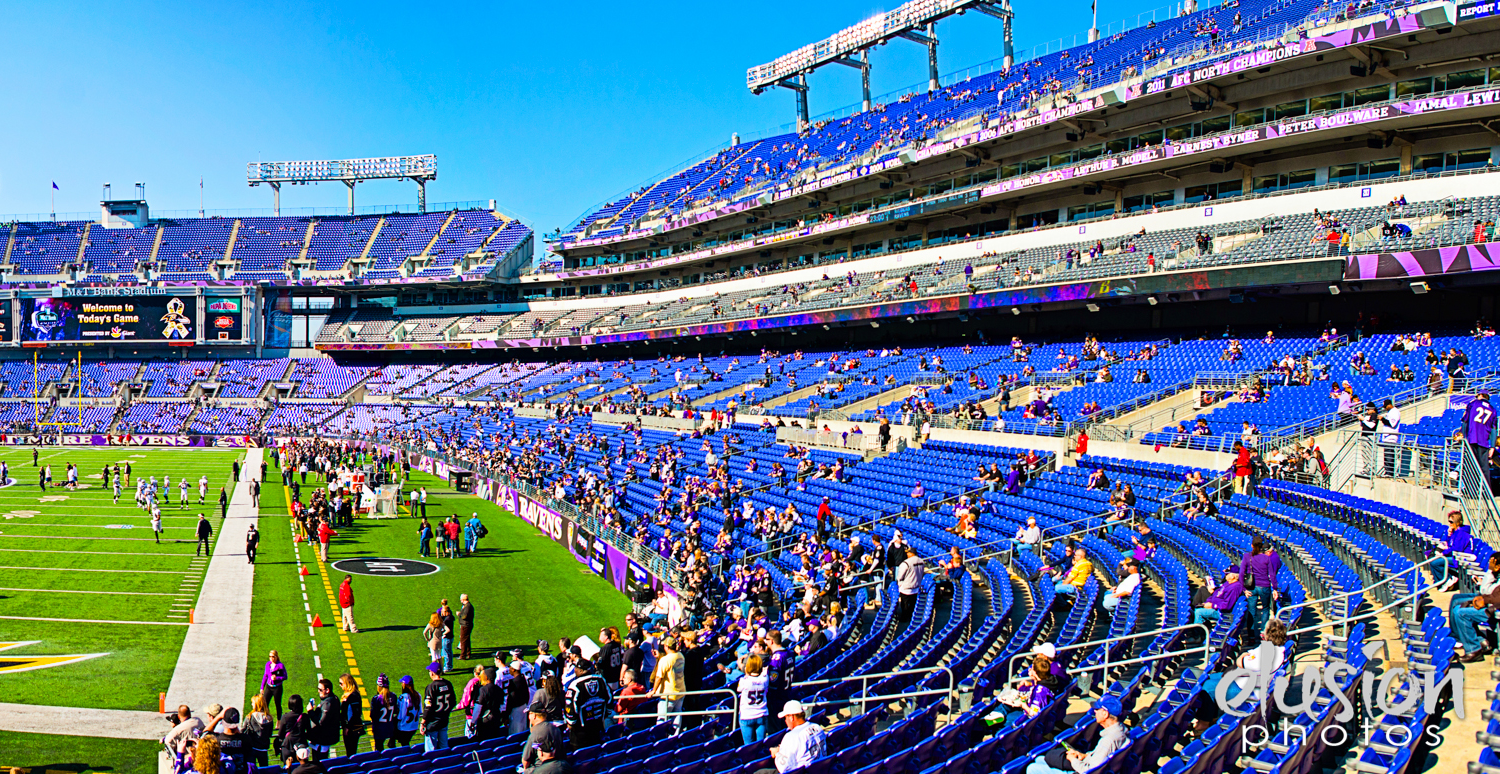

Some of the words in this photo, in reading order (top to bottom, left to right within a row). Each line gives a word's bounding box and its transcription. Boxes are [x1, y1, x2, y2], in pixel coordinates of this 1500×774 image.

[1460, 3, 1495, 17] REPORT
[1147, 80, 1165, 94] 2011
[1171, 72, 1190, 87] AFC
[1193, 62, 1230, 81] NORTH
[1233, 43, 1300, 71] CHAMPIONS
[1413, 97, 1457, 113] JAMAL
[980, 129, 996, 141] 2006
[1000, 123, 1013, 135] AFC
[1014, 115, 1042, 130] NORTH
[1044, 100, 1093, 122] CHAMPIONS
[1279, 120, 1316, 135] PETER
[1320, 107, 1389, 127] BOULWARE
[917, 142, 954, 159] CHAMPIONS
[1173, 139, 1220, 155] EARNEST
[1222, 130, 1259, 146] BYNER
[1074, 162, 1108, 176] ARTHUR
[1111, 159, 1119, 167] B.
[1122, 151, 1158, 166] MODELL
[821, 172, 851, 188] CHAMPIONS
[983, 184, 1000, 195] RING
[1002, 182, 1012, 191] OF
[1013, 176, 1040, 189] HONOR
[870, 213, 884, 223] 23:00
[67, 287, 89, 296] M&T
[93, 287, 120, 295] Bank
[123, 287, 166, 295] Stadium
[82, 303, 123, 313] Welcome
[124, 304, 134, 312] to
[77, 314, 111, 325] Today's
[113, 313, 139, 323] Game
[1473, 407, 1493, 424] 27
[518, 498, 562, 539] RAVENS
[610, 653, 621, 668] 80
[435, 693, 451, 712] 55
[748, 689, 764, 705] 55
[379, 706, 394, 722] 27
